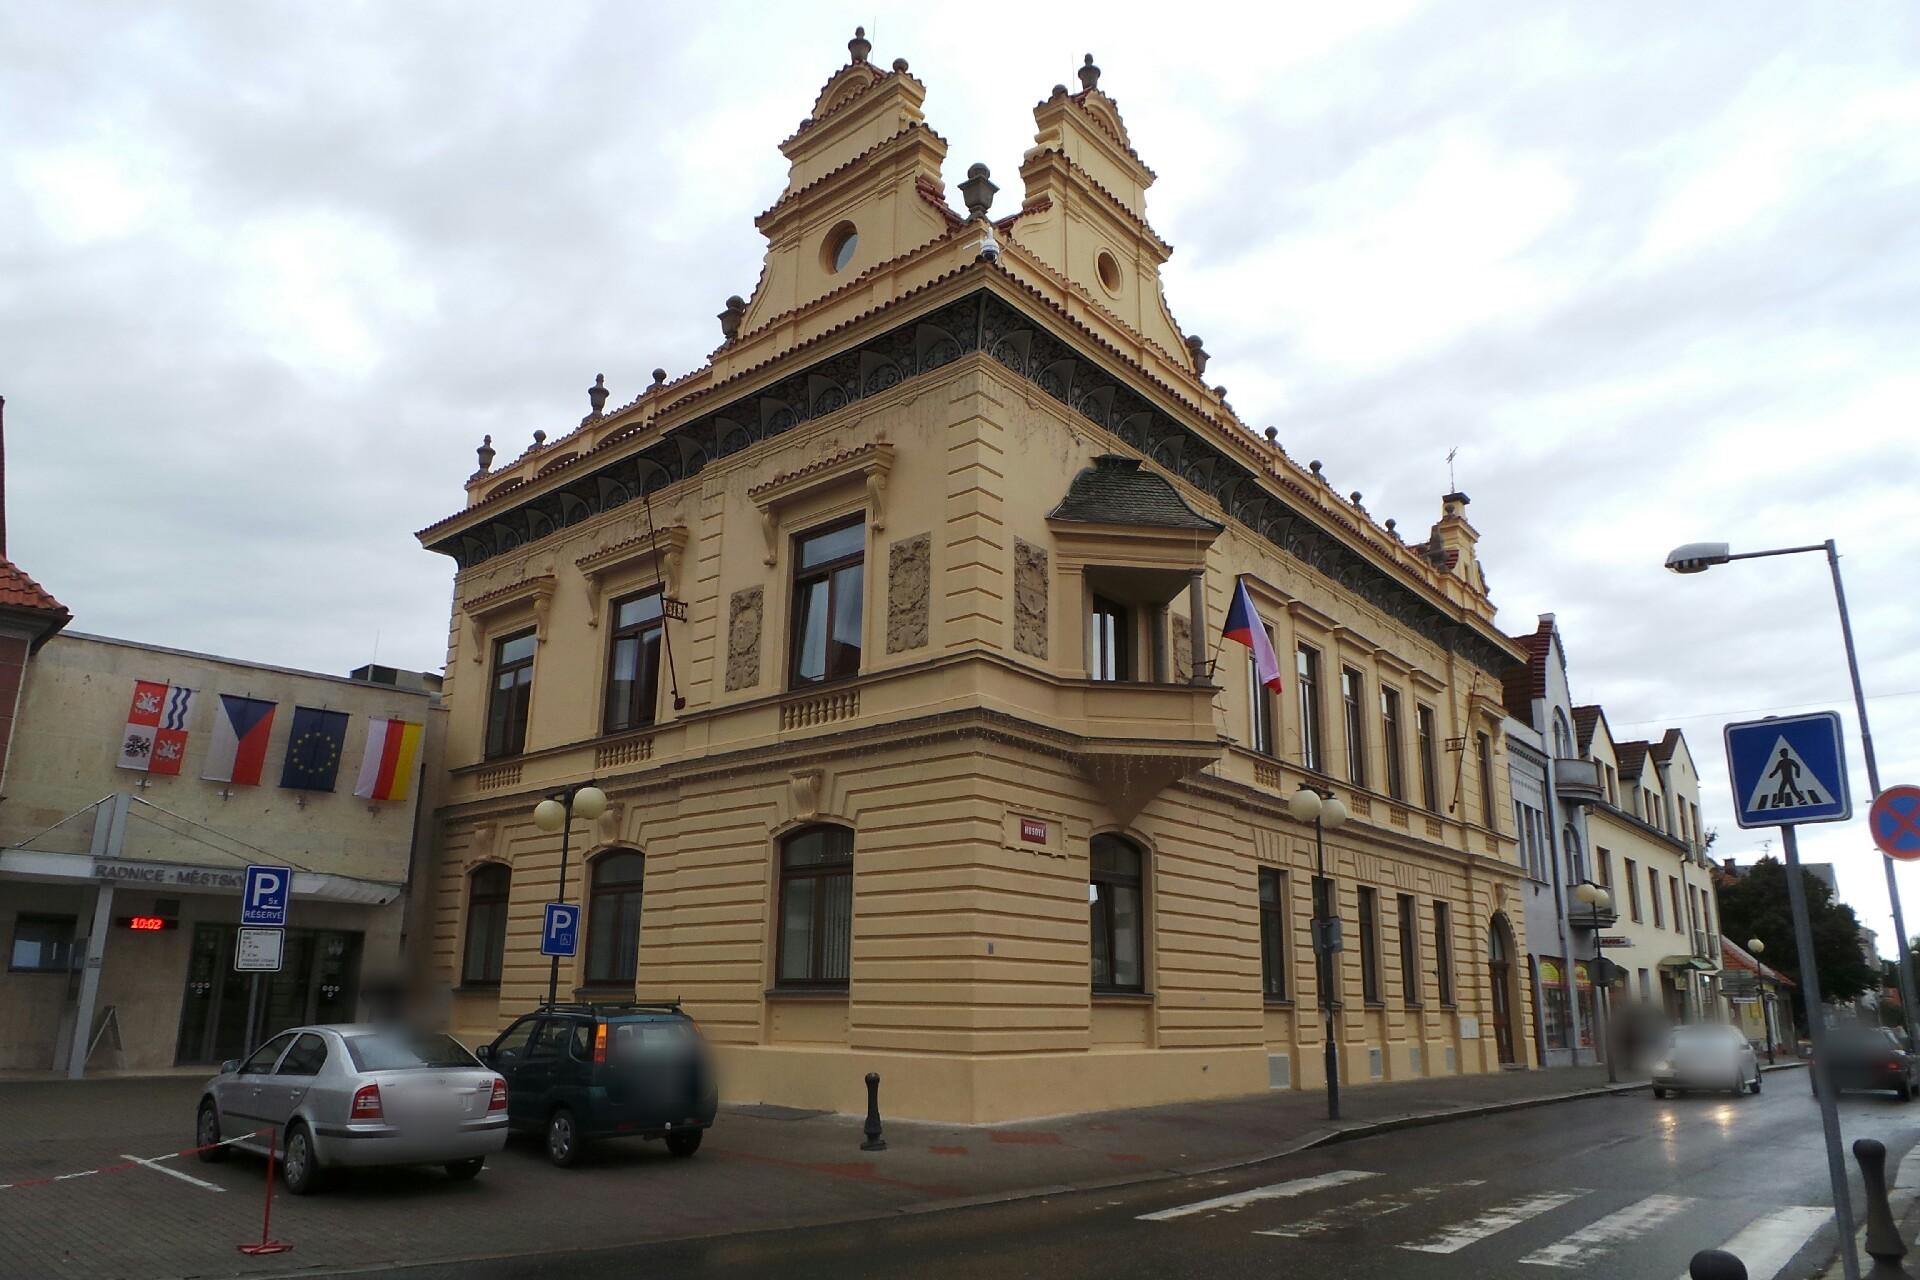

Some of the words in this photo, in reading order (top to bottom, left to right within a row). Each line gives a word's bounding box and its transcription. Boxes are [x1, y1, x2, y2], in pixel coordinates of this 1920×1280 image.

[1024, 826, 1045, 838] HUSOVA
[95, 864, 165, 881] RADNICE
[252, 873, 280, 906] P
[130, 916, 162, 929] 10:02
[550, 909, 572, 939] P
